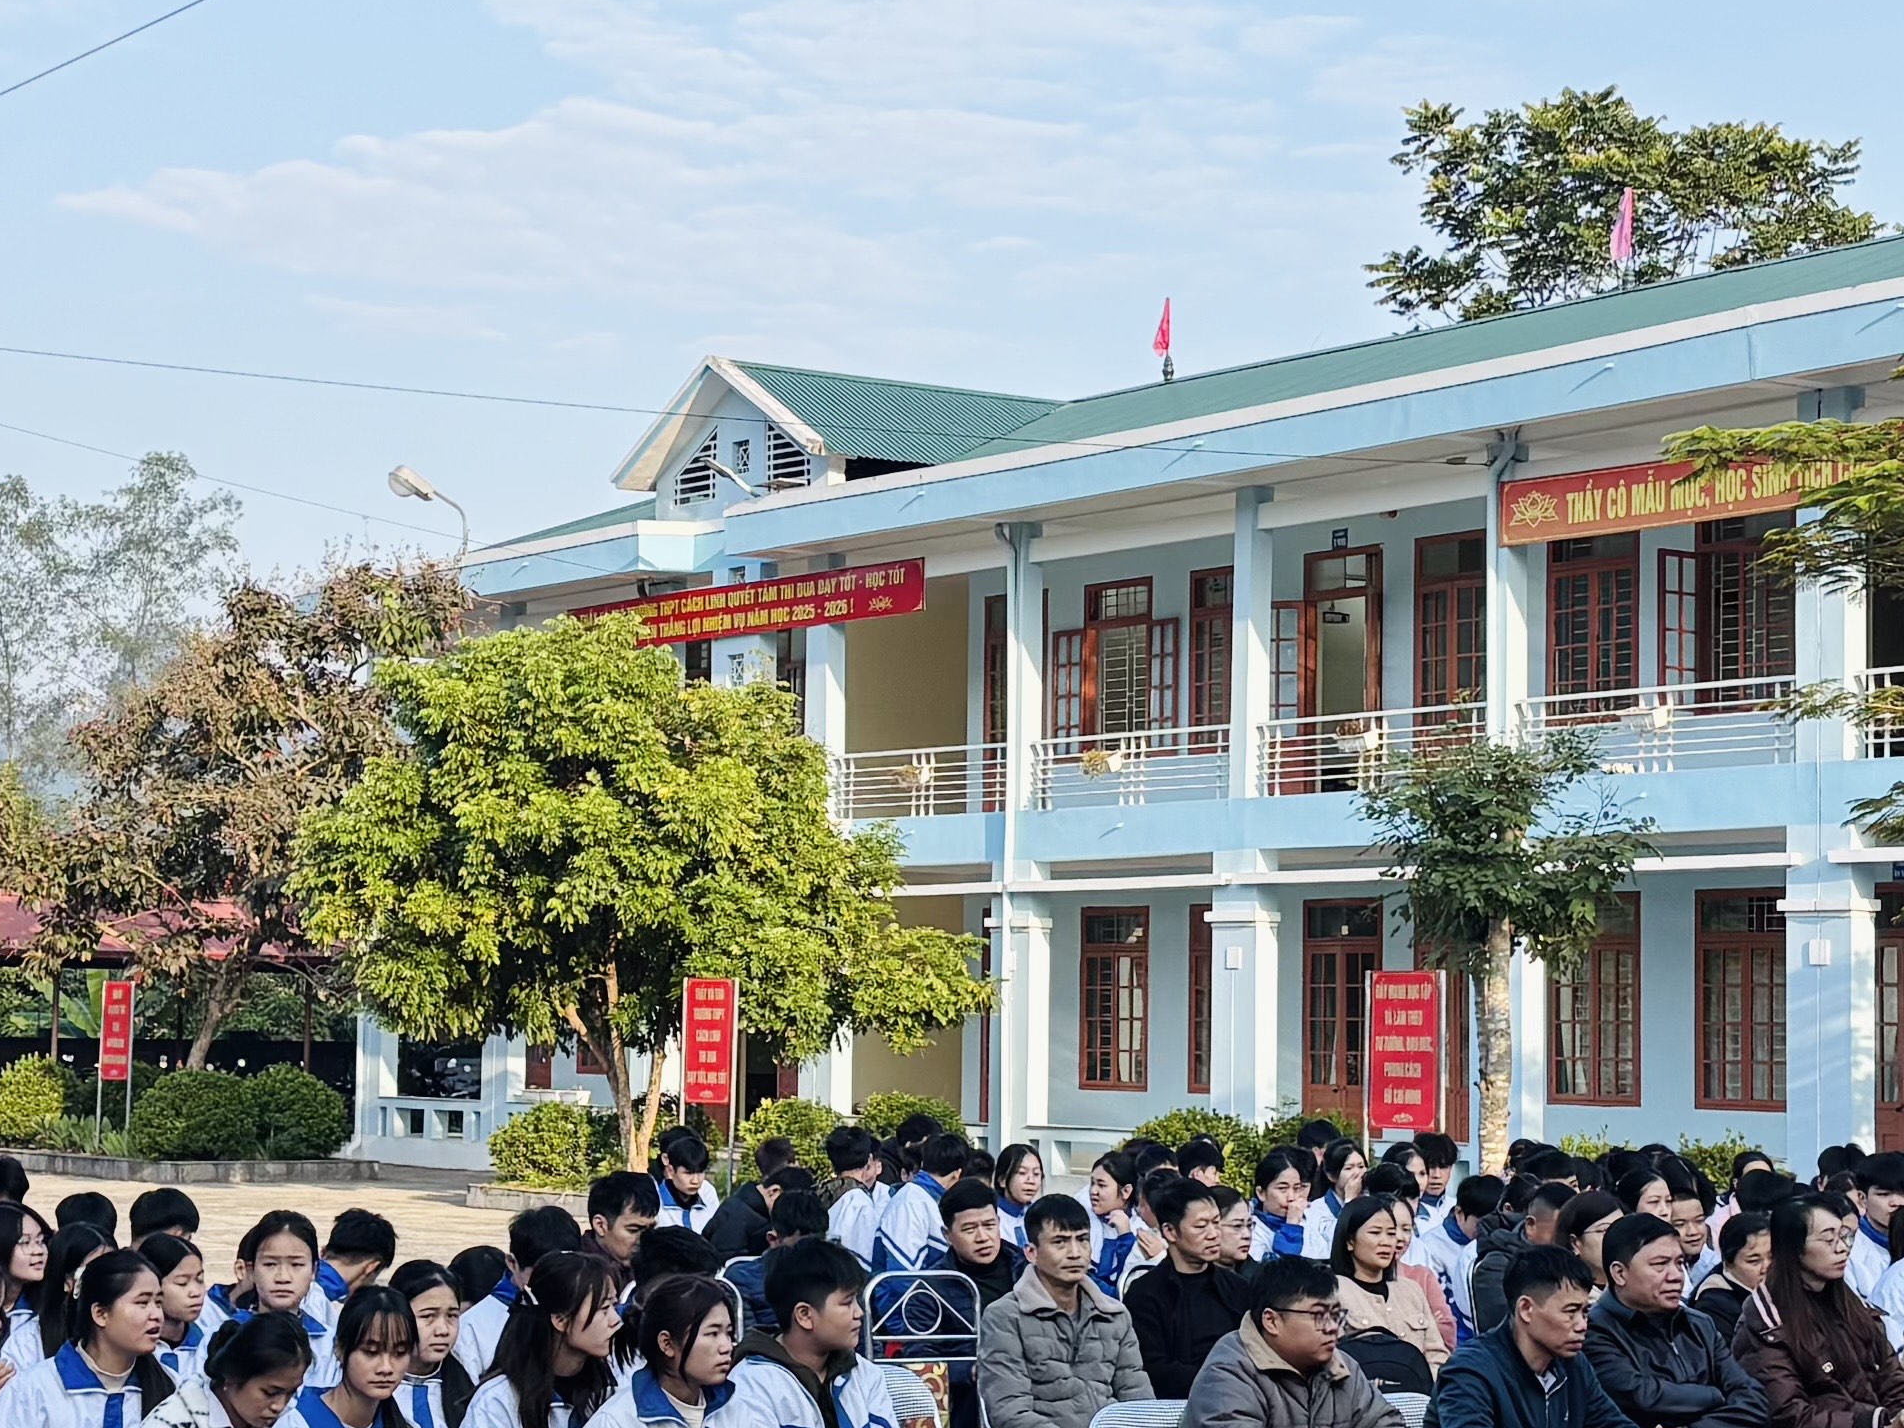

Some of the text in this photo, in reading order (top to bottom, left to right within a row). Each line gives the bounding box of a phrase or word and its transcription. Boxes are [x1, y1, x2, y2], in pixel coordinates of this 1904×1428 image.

[1566, 478, 1603, 524] THẦY
[1607, 479, 1627, 520] CÔ
[1631, 469, 1666, 516] MẪU
[1715, 468, 1747, 510] HỌC
[1751, 462, 1791, 499] SINH
[659, 600, 680, 618] THPT
[681, 594, 704, 614] CÁCH
[705, 592, 726, 610] LINH
[727, 581, 756, 607] QUYẾT
[757, 583, 778, 603] TÂM
[780, 584, 795, 600] THI
[839, 571, 858, 593] TỐT
[865, 570, 887, 591] HỌC
[887, 565, 905, 585] TỐT
[733, 612, 745, 632] VỤ
[747, 606, 769, 628] NĂM
[770, 606, 790, 629] HỌC
[791, 603, 815, 621] 2025
[824, 599, 848, 617] 2026
